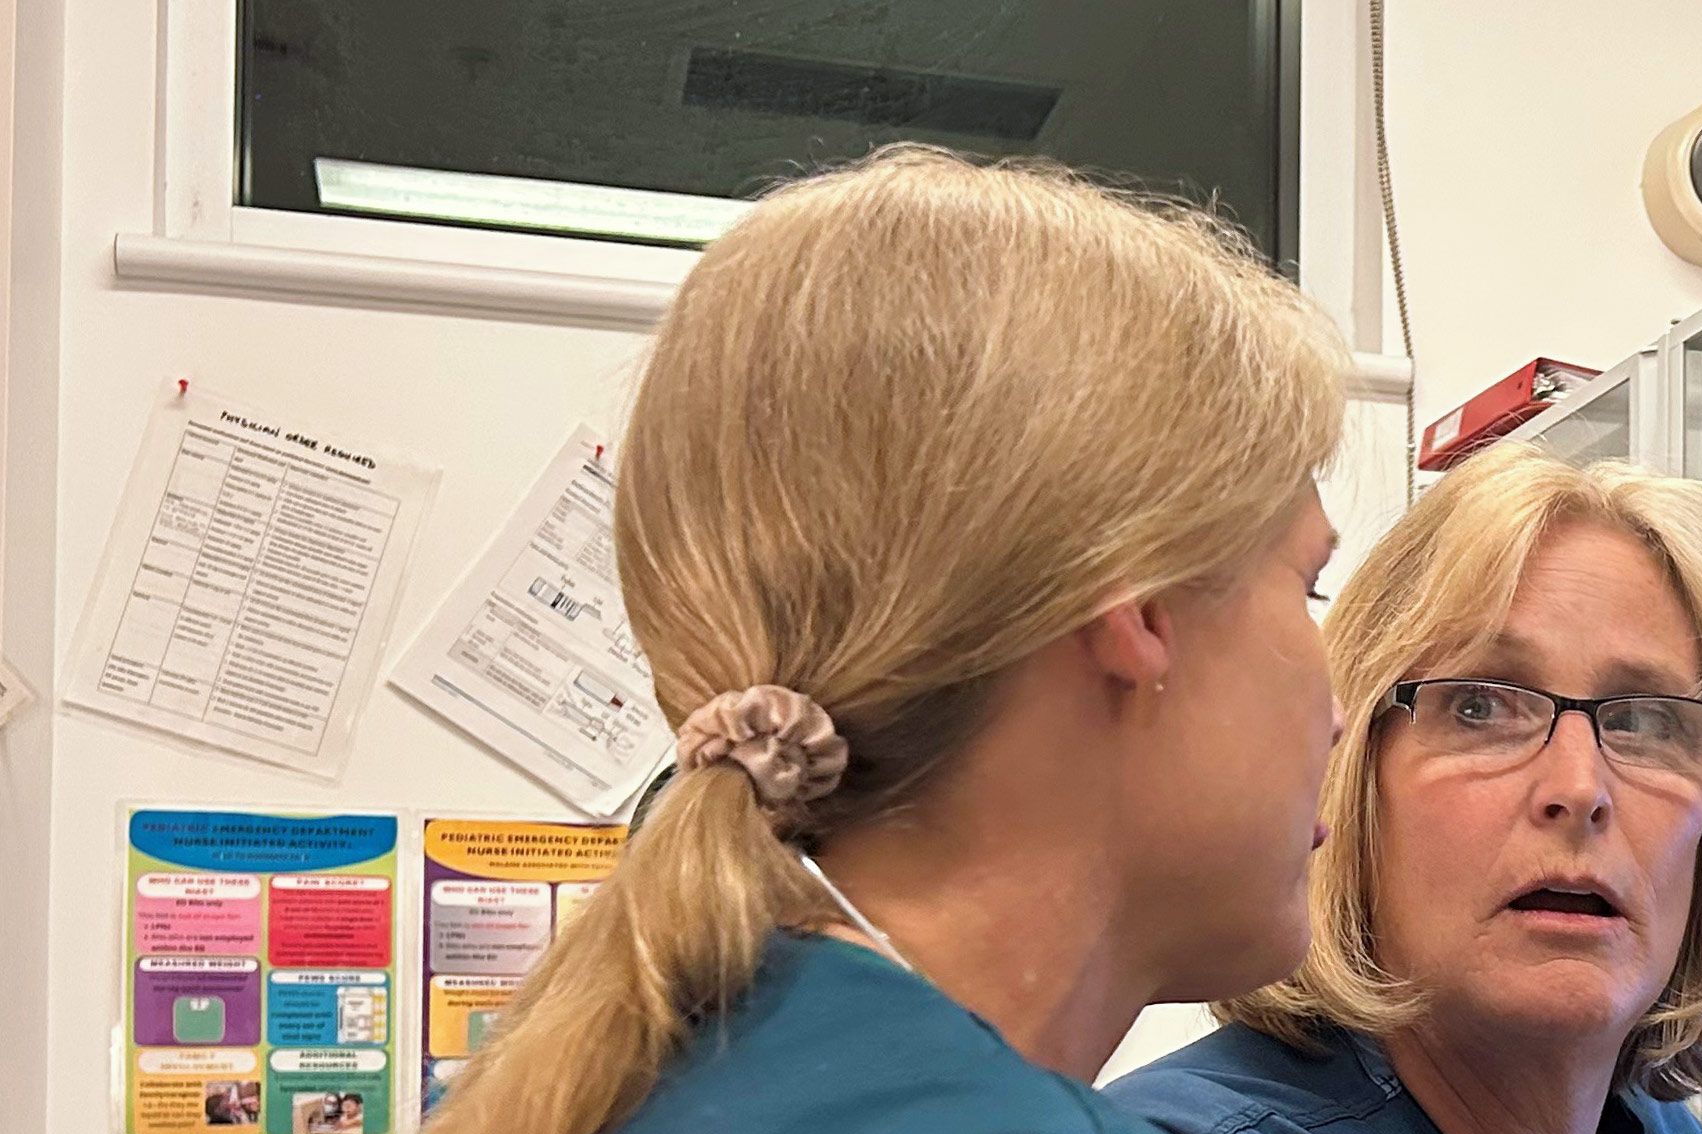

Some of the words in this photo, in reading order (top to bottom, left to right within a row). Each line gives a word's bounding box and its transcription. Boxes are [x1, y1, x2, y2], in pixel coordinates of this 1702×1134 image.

[440, 832, 504, 843] PEDIATRIC
[507, 833, 578, 845] EMERGENCY
[467, 847, 507, 856] NURSE
[510, 847, 572, 857] INITIATED
